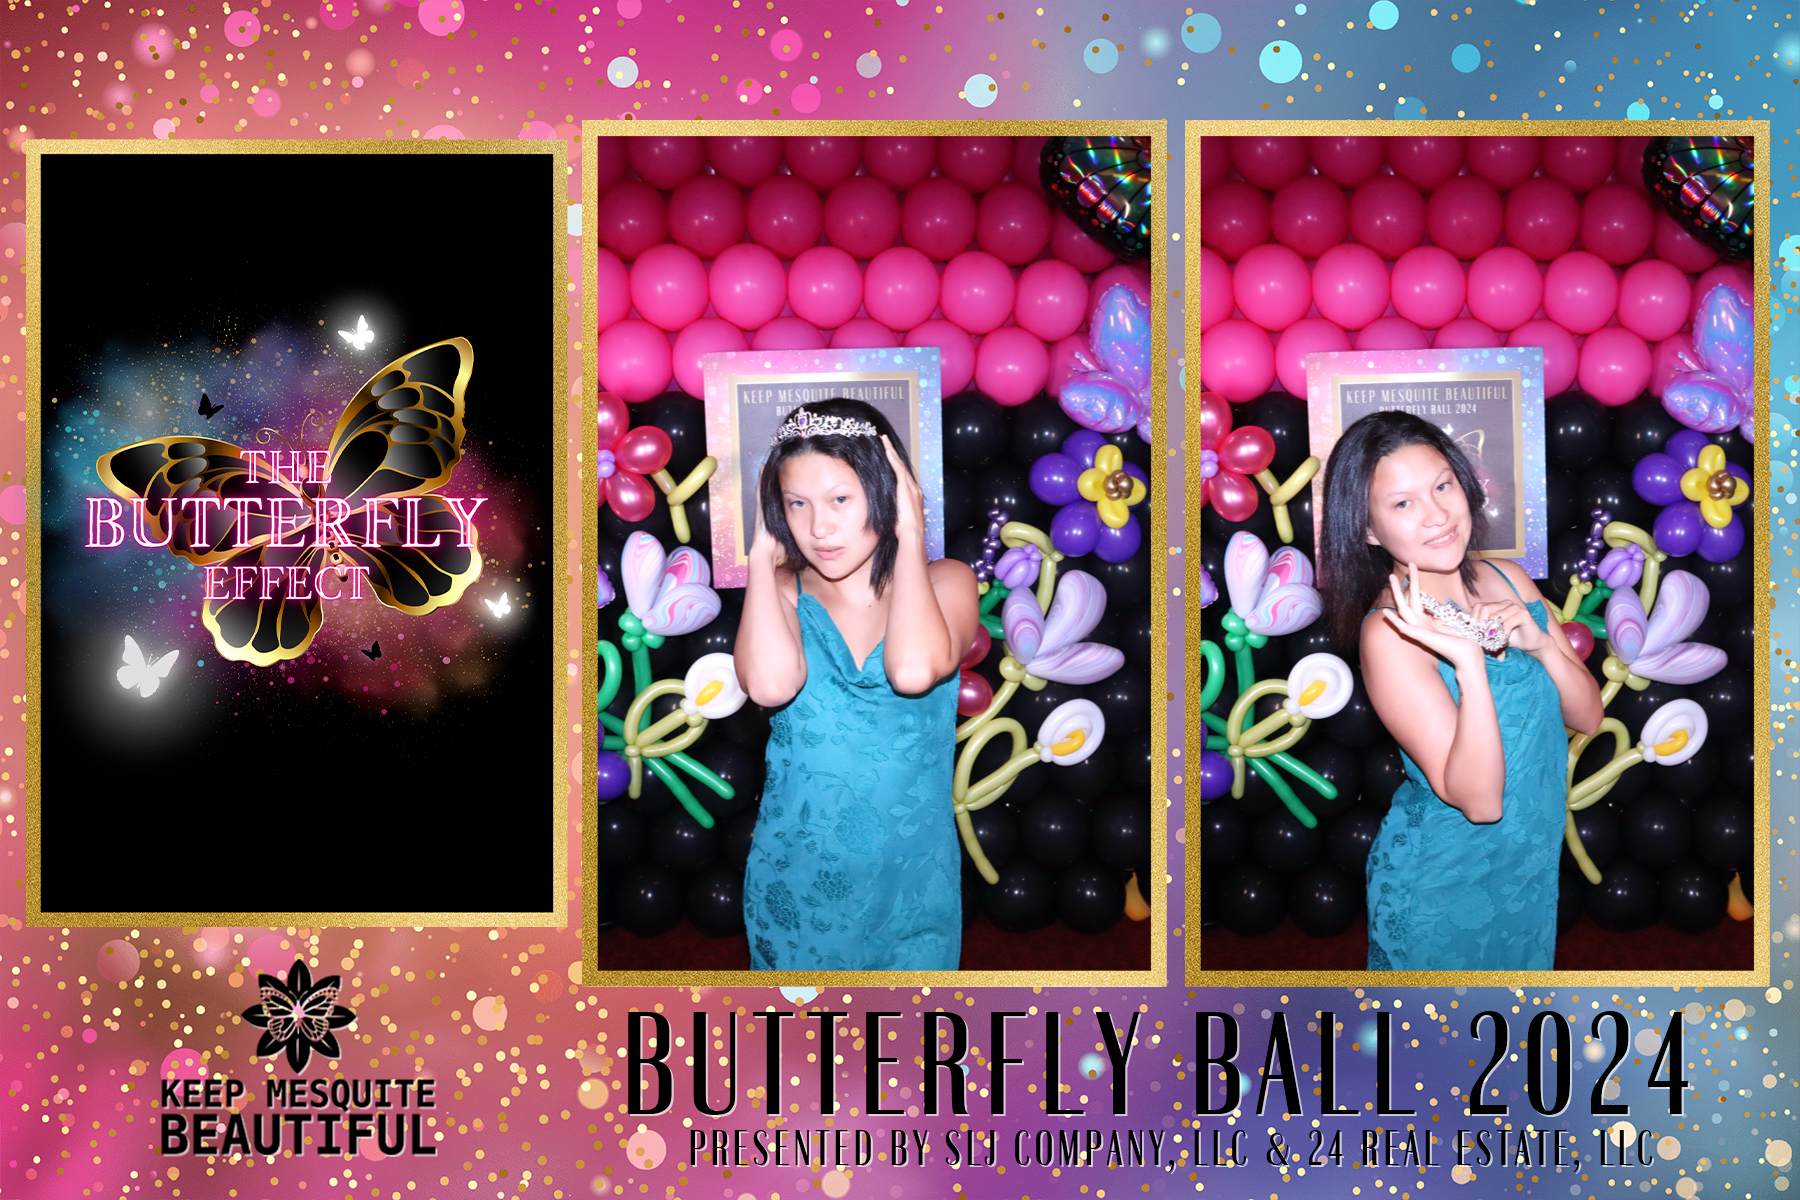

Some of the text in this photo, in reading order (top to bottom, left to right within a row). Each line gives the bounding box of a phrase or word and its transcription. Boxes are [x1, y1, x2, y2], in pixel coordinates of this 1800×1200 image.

[743, 386, 905, 404] KEEP MESQUITE BEAUTIFUL
[1346, 386, 1508, 404] KEEP MESQUITE BEAUTIFUL
[1430, 404, 1452, 415] BALL
[1455, 403, 1477, 414] 2024
